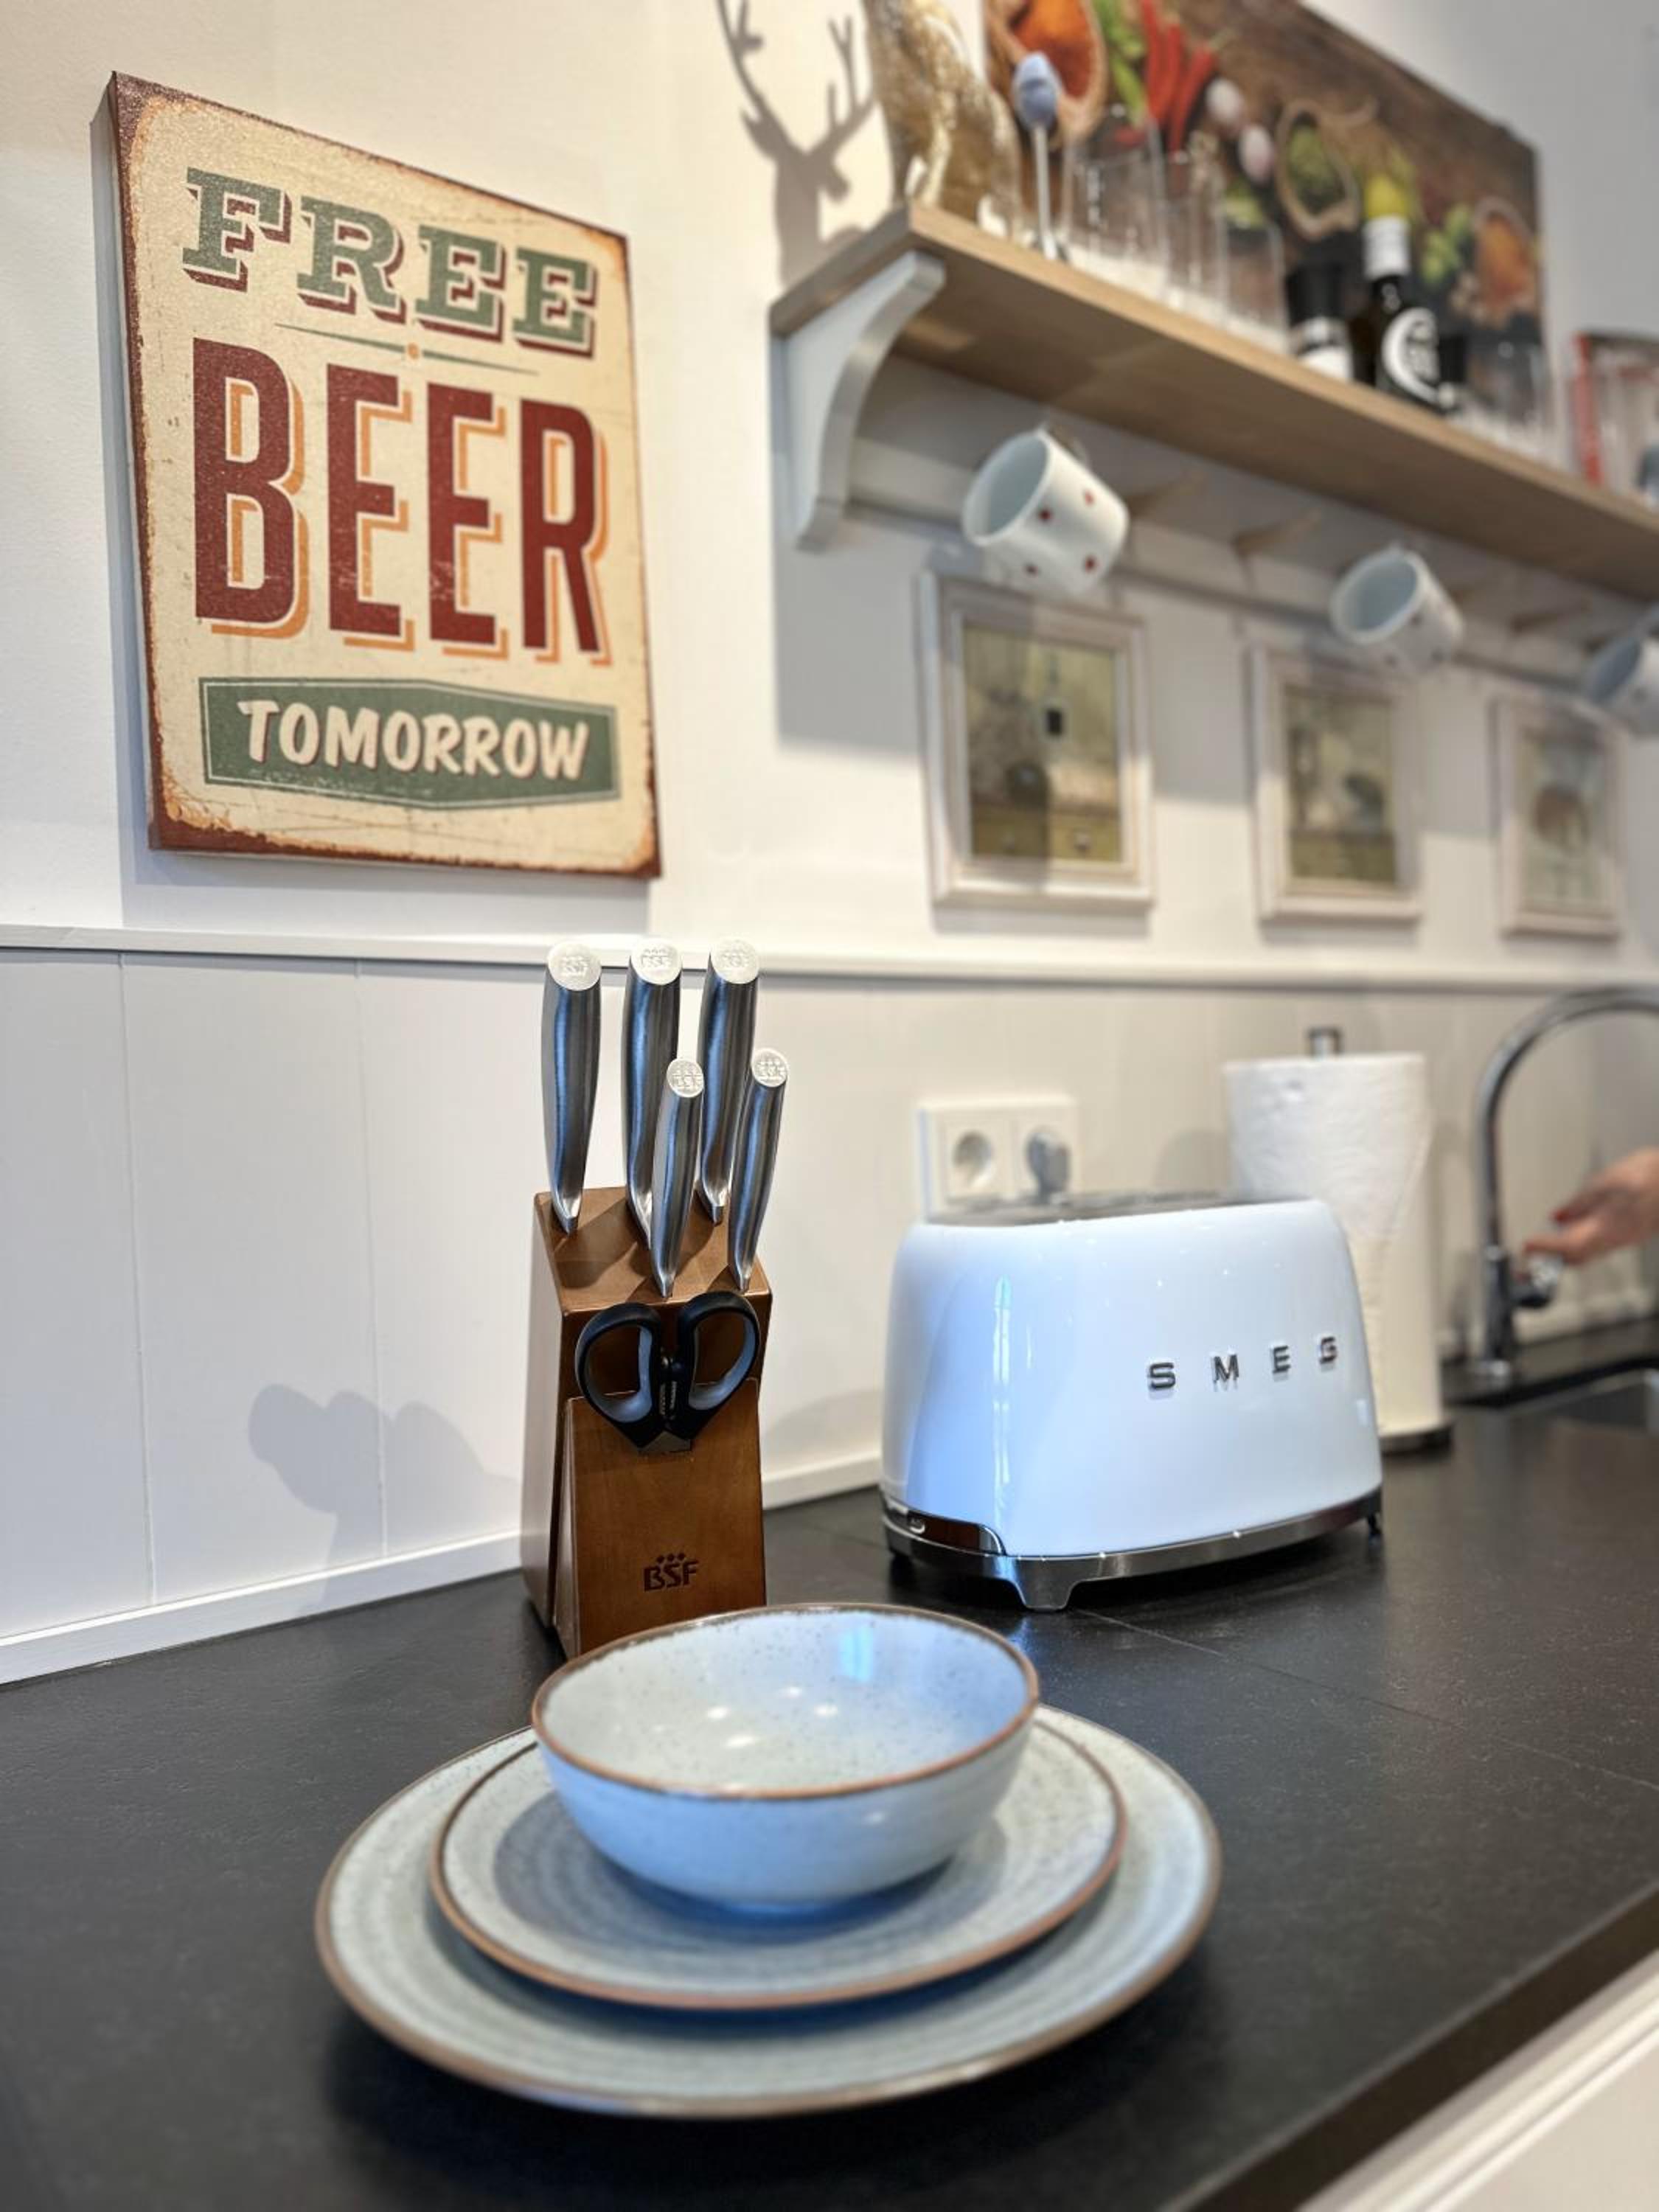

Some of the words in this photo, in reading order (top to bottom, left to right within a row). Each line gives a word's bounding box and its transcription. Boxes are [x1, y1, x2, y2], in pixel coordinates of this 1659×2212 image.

[182, 167, 598, 359] FREE
[193, 338, 613, 667] BEER
[237, 699, 589, 780] TOMORROW
[1148, 1336, 1338, 1391] SMEG
[644, 1557, 699, 1593] BSF
